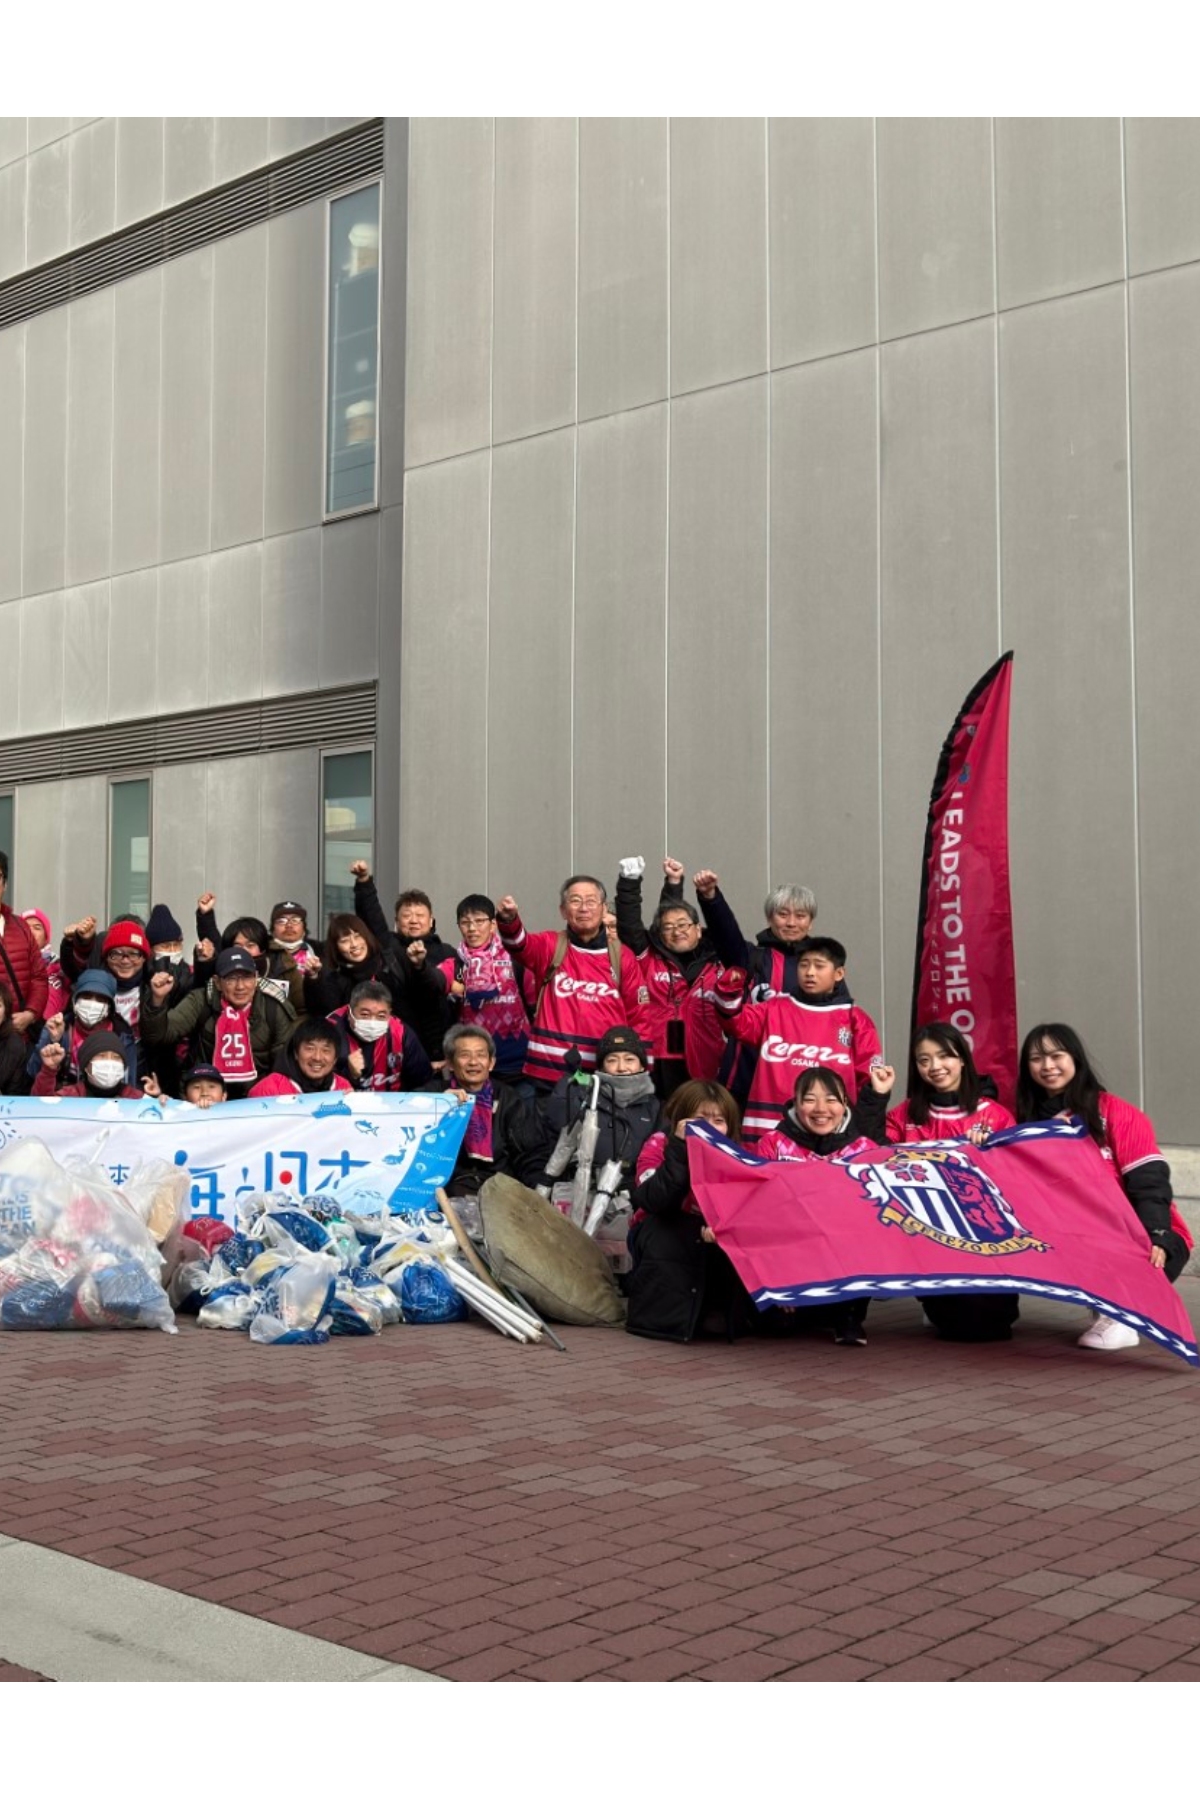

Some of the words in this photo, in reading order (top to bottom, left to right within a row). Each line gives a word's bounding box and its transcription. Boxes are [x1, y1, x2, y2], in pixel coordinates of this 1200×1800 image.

[939, 791, 963, 891] EADS
[940, 895, 964, 939] TO
[944, 944, 972, 1004] THE
[221, 1033, 246, 1058] 25
[909, 1220, 982, 1253] CEREZO
